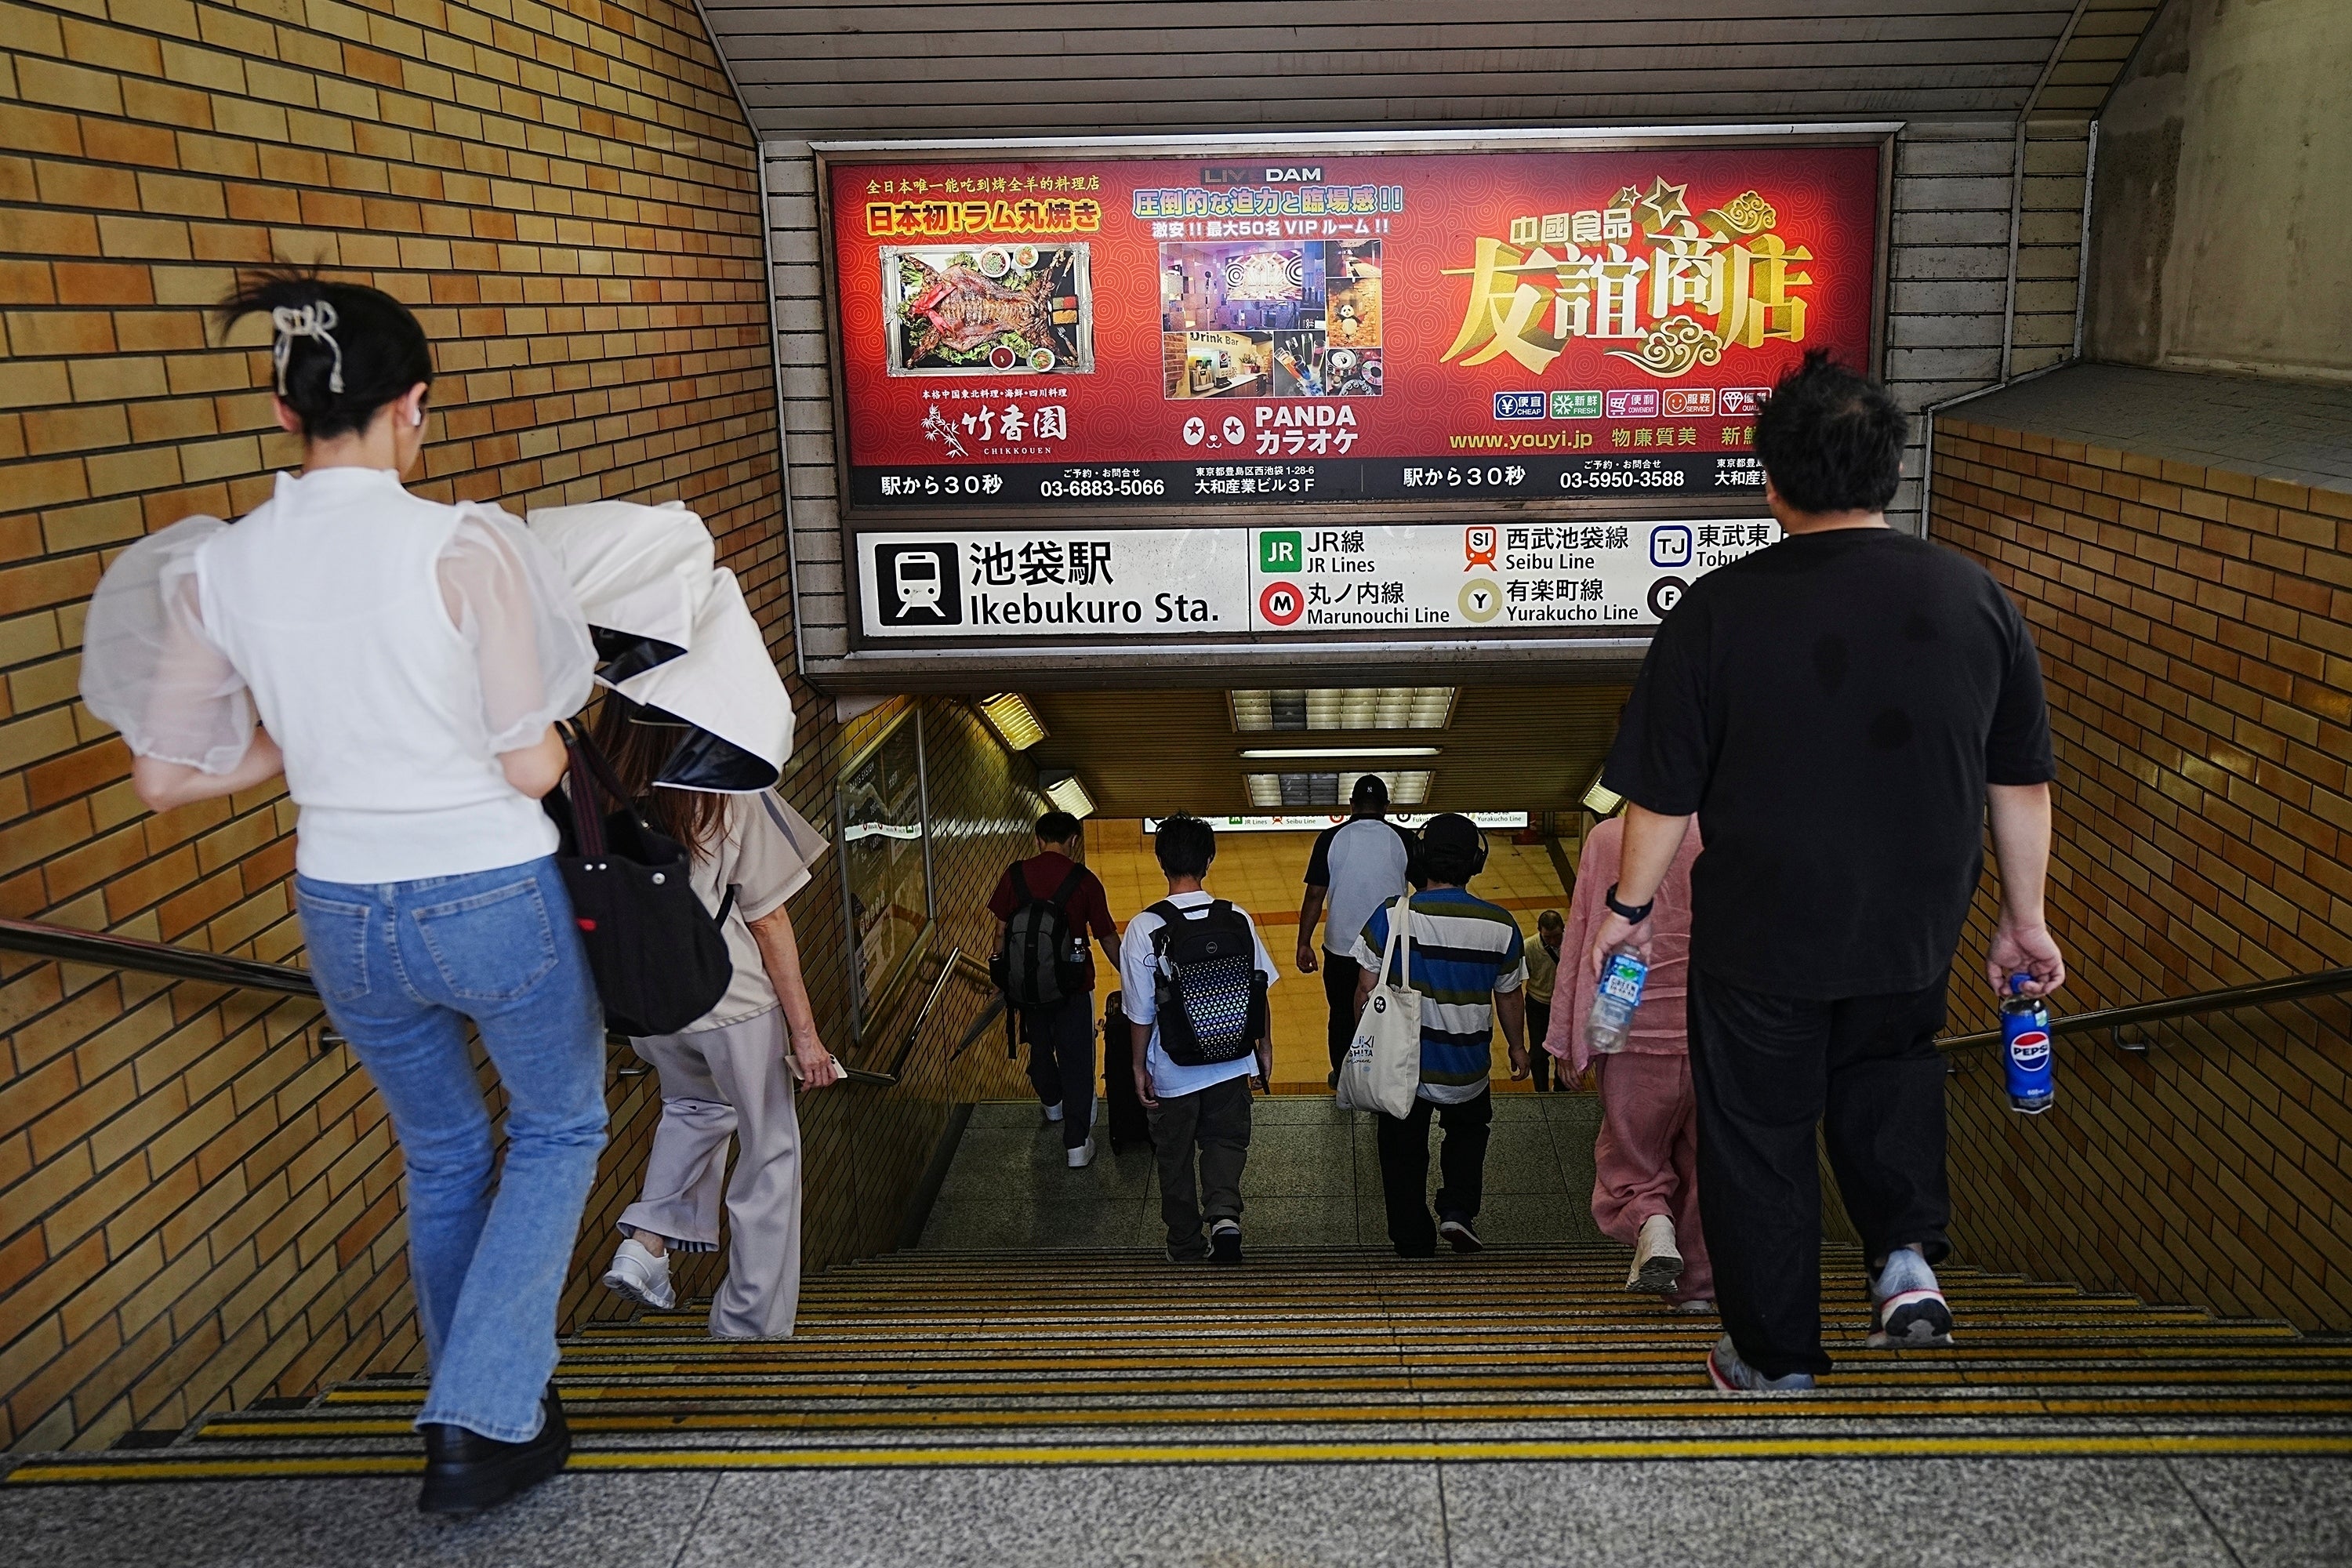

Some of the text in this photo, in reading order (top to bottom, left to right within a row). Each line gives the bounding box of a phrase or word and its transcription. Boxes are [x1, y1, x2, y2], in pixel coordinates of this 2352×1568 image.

[866, 175, 1100, 194] 全日本唯一能吃到烤全羊的料理店
[1205, 168, 1321, 183] LIV DAM
[866, 199, 1102, 235] 日本初!ラム丸焼き
[1509, 207, 1634, 245] 中國食品
[1439, 220, 1813, 376] 友誼商店
[1225, 336, 1240, 346] Bar
[1518, 396, 1541, 407] 便宜
[1574, 395, 1598, 406] 新鮮
[1631, 394, 1653, 405] 便利
[1687, 394, 1711, 404] 服務
[961, 404, 1067, 441] 竹香園
[1255, 405, 1357, 427] PANDA
[1256, 430, 1358, 456] カラオケ
[1450, 430, 1593, 450] www.youyi.jp
[1612, 426, 1697, 447] 物廉質美
[1063, 468, 1141, 478] ご予約・お問合せ
[1584, 459, 1661, 470] ご予約・お問合せ
[881, 474, 1004, 495] 駅から30秒
[1403, 465, 1526, 488] 駅から30秒
[1560, 470, 1685, 488] 03-5950-3588
[1040, 478, 1165, 497] 03-6883-5066
[1195, 478, 1315, 495] 大和産業ビル3F
[1307, 530, 1365, 554] JR線
[1472, 532, 1489, 546] SI
[1506, 525, 1629, 551] 西武池袋線
[1658, 539, 1685, 554] TJ
[1268, 542, 1294, 562] JR
[1697, 550, 1738, 567] Tobu
[969, 540, 1114, 586] 池袋駅
[1307, 557, 1375, 573] JR Lines
[1505, 553, 1595, 570] Seibu Line
[1308, 582, 1404, 605] 丸ノ内線
[1506, 579, 1604, 602] 有楽町線
[1664, 592, 1675, 607] F
[971, 592, 1219, 625] Ikebukuro Sta.
[1273, 596, 1292, 611] M
[1474, 593, 1487, 608] Y
[1308, 608, 1450, 624] Marunouchi Line
[1506, 604, 1639, 622] Yurakucho Line
